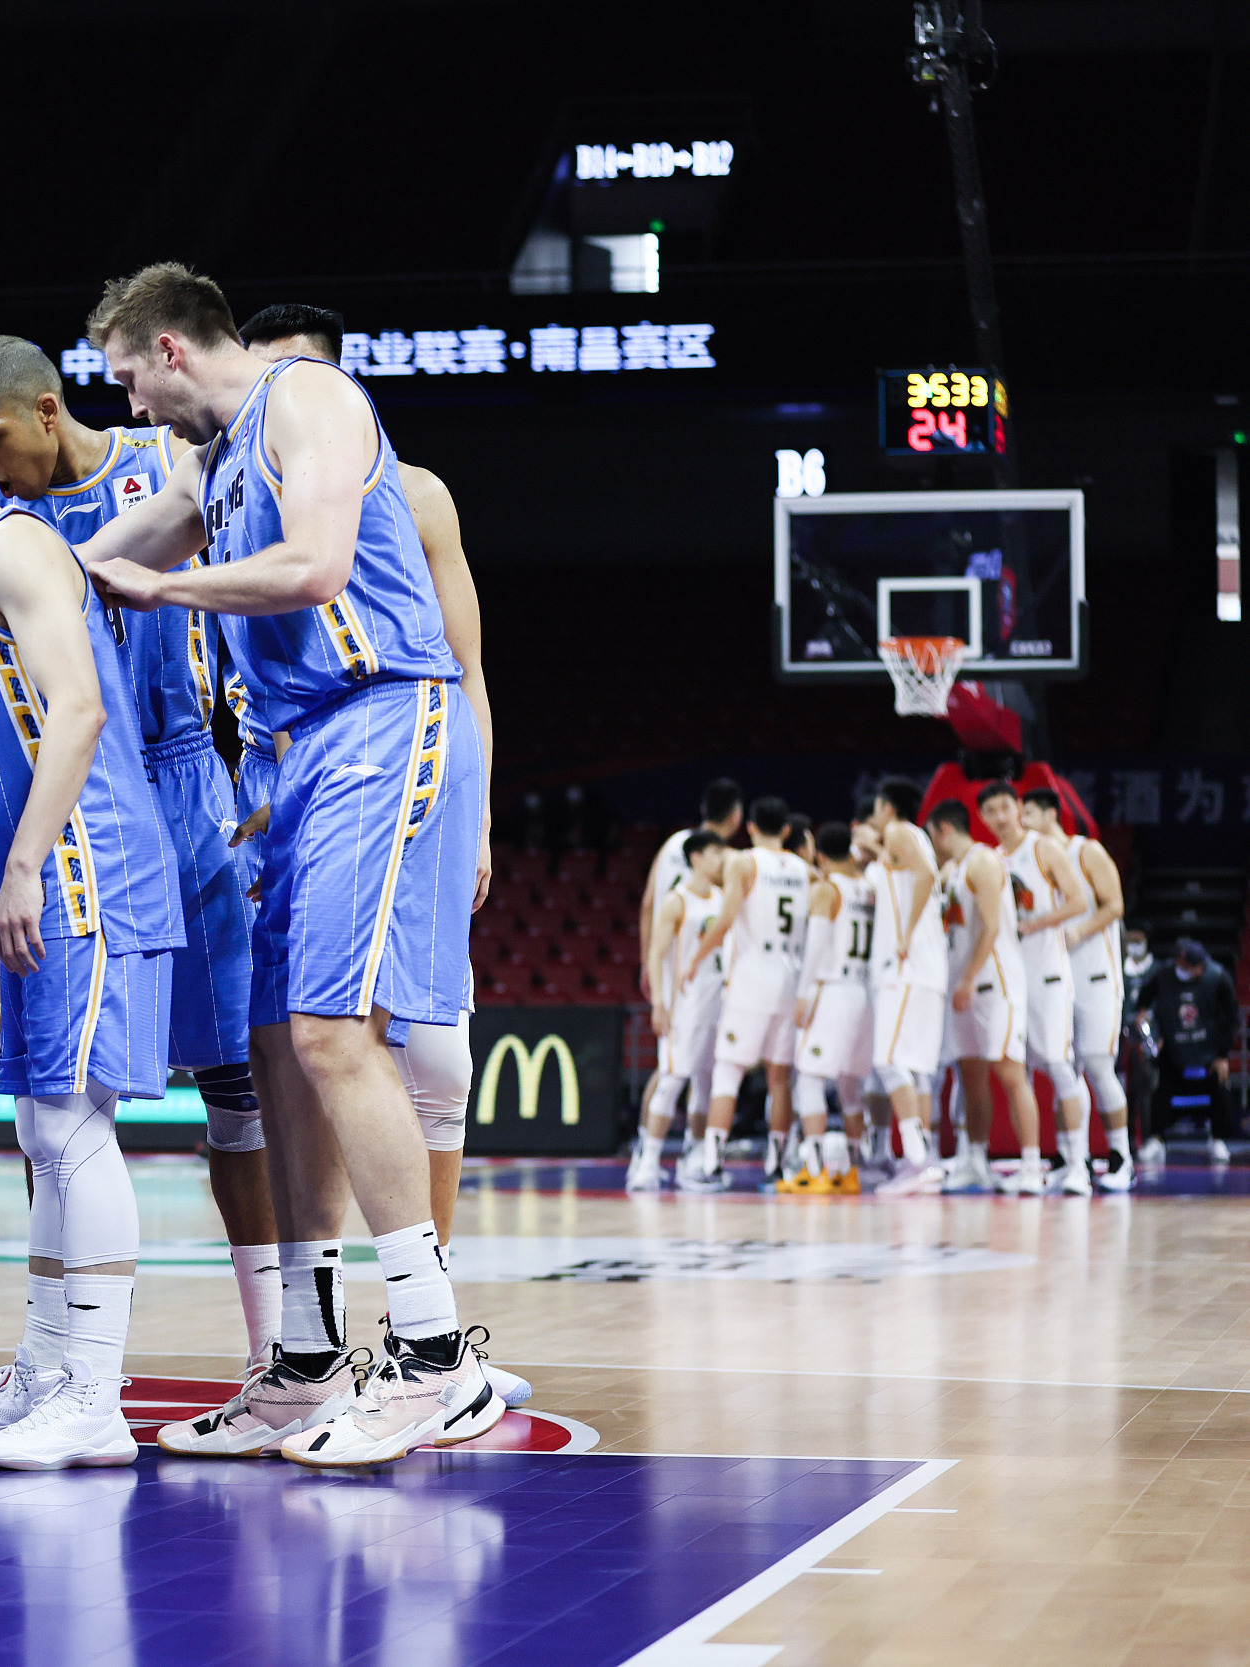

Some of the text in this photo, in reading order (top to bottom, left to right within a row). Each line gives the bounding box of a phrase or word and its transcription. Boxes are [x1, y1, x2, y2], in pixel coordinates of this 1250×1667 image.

[907, 408, 967, 452] 24
[775, 448, 827, 498] B6
[778, 896, 793, 935] 5
[847, 919, 875, 962] 11
